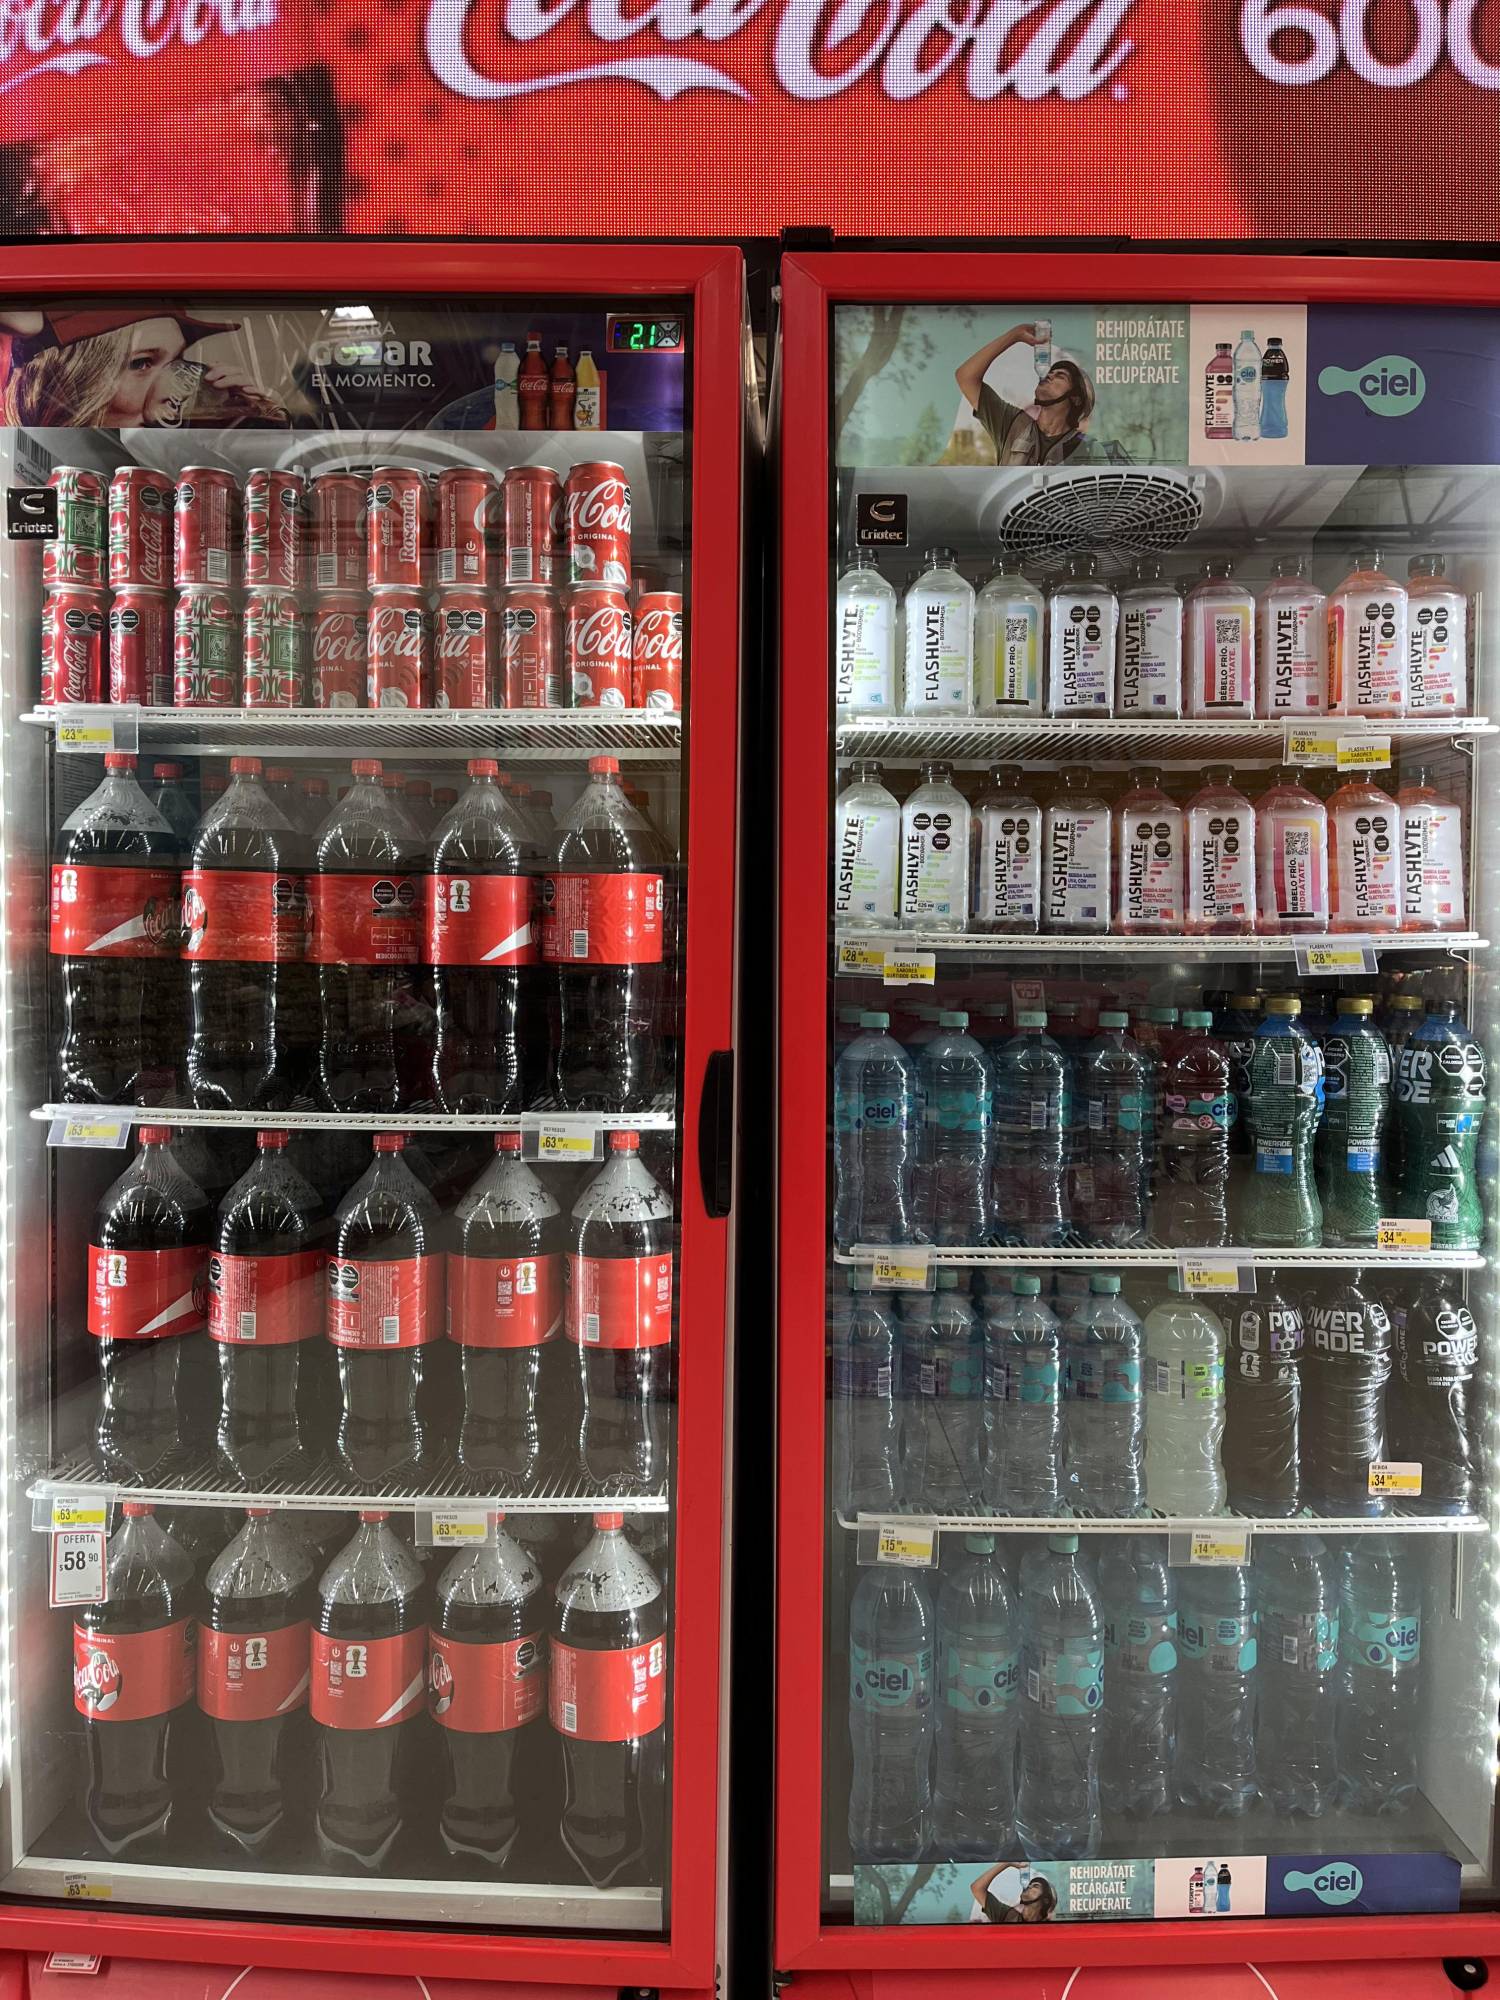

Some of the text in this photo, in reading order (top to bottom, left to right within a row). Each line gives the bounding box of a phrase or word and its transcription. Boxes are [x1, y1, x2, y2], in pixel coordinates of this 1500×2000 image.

[347, 321, 397, 336] PARA
[1096, 315, 1185, 338] REHIDRÁTATE
[1096, 339, 1173, 361] RECÁRGATE
[311, 373, 436, 389] EL MOMENTO.
[1095, 362, 1180, 384] RECUPÉRATE
[1240, 368, 1257, 378] ciel
[1358, 367, 1418, 398] ciel
[1205, 373, 1215, 426] FLASHLYTE
[12, 522, 54, 533] Criotec
[399, 488, 417, 563] Rosenda
[578, 533, 618, 541] ORIGINAL
[860, 529, 903, 541] Criotec
[139, 512, 163, 584] Coca-Cola
[576, 660, 615, 669] ORIGINAL
[837, 607, 859, 705] FLASHLYTE
[925, 605, 940, 701] FLASHLYTE
[1063, 627, 1078, 706] FLASHLYTE
[1123, 613, 1140, 709] FLASHLYTE
[1275, 610, 1292, 707] FLASHLYTE
[1358, 625, 1372, 705] FLASHLYTE
[63, 635, 88, 703] Coca-Cola
[1008, 667, 1016, 699] BÉBELO
[1218, 645, 1228, 701] BÉBELO FRÍO.
[1228, 647, 1236, 701] HIDRATATE.
[1410, 630, 1425, 708] FLASHLYTE
[837, 818, 860, 911] FLASHLYTE
[905, 835, 920, 913] FLASHLYTE
[994, 840, 1008, 917] FLASHLYTE
[1050, 821, 1070, 918] FLASHLYTE
[1202, 840, 1217, 917] FLASHLYTE
[1352, 839, 1370, 917] FLASHLYTE
[1404, 819, 1422, 914] FLASHLYTE
[1128, 844, 1143, 919] FLASHLYTE
[1288, 857, 1299, 912] BÉBELO FRÍO.
[864, 1102, 897, 1119] ciel
[542, 1136, 556, 1148] $63
[1380, 1231, 1394, 1243] $34
[1371, 1474, 1385, 1486] $34
[63, 1534, 96, 1544] OFERTA
[436, 1523, 450, 1535] $63
[59, 1550, 99, 1571] $58 90
[864, 1666, 910, 1691] ciel
[1069, 1862, 1136, 1879] REHIDRÁTATE
[1313, 1870, 1357, 1892] ciel
[1069, 1879, 1127, 1895] RECÁRGATE
[1069, 1895, 1132, 1911] RECUPÉRATE
